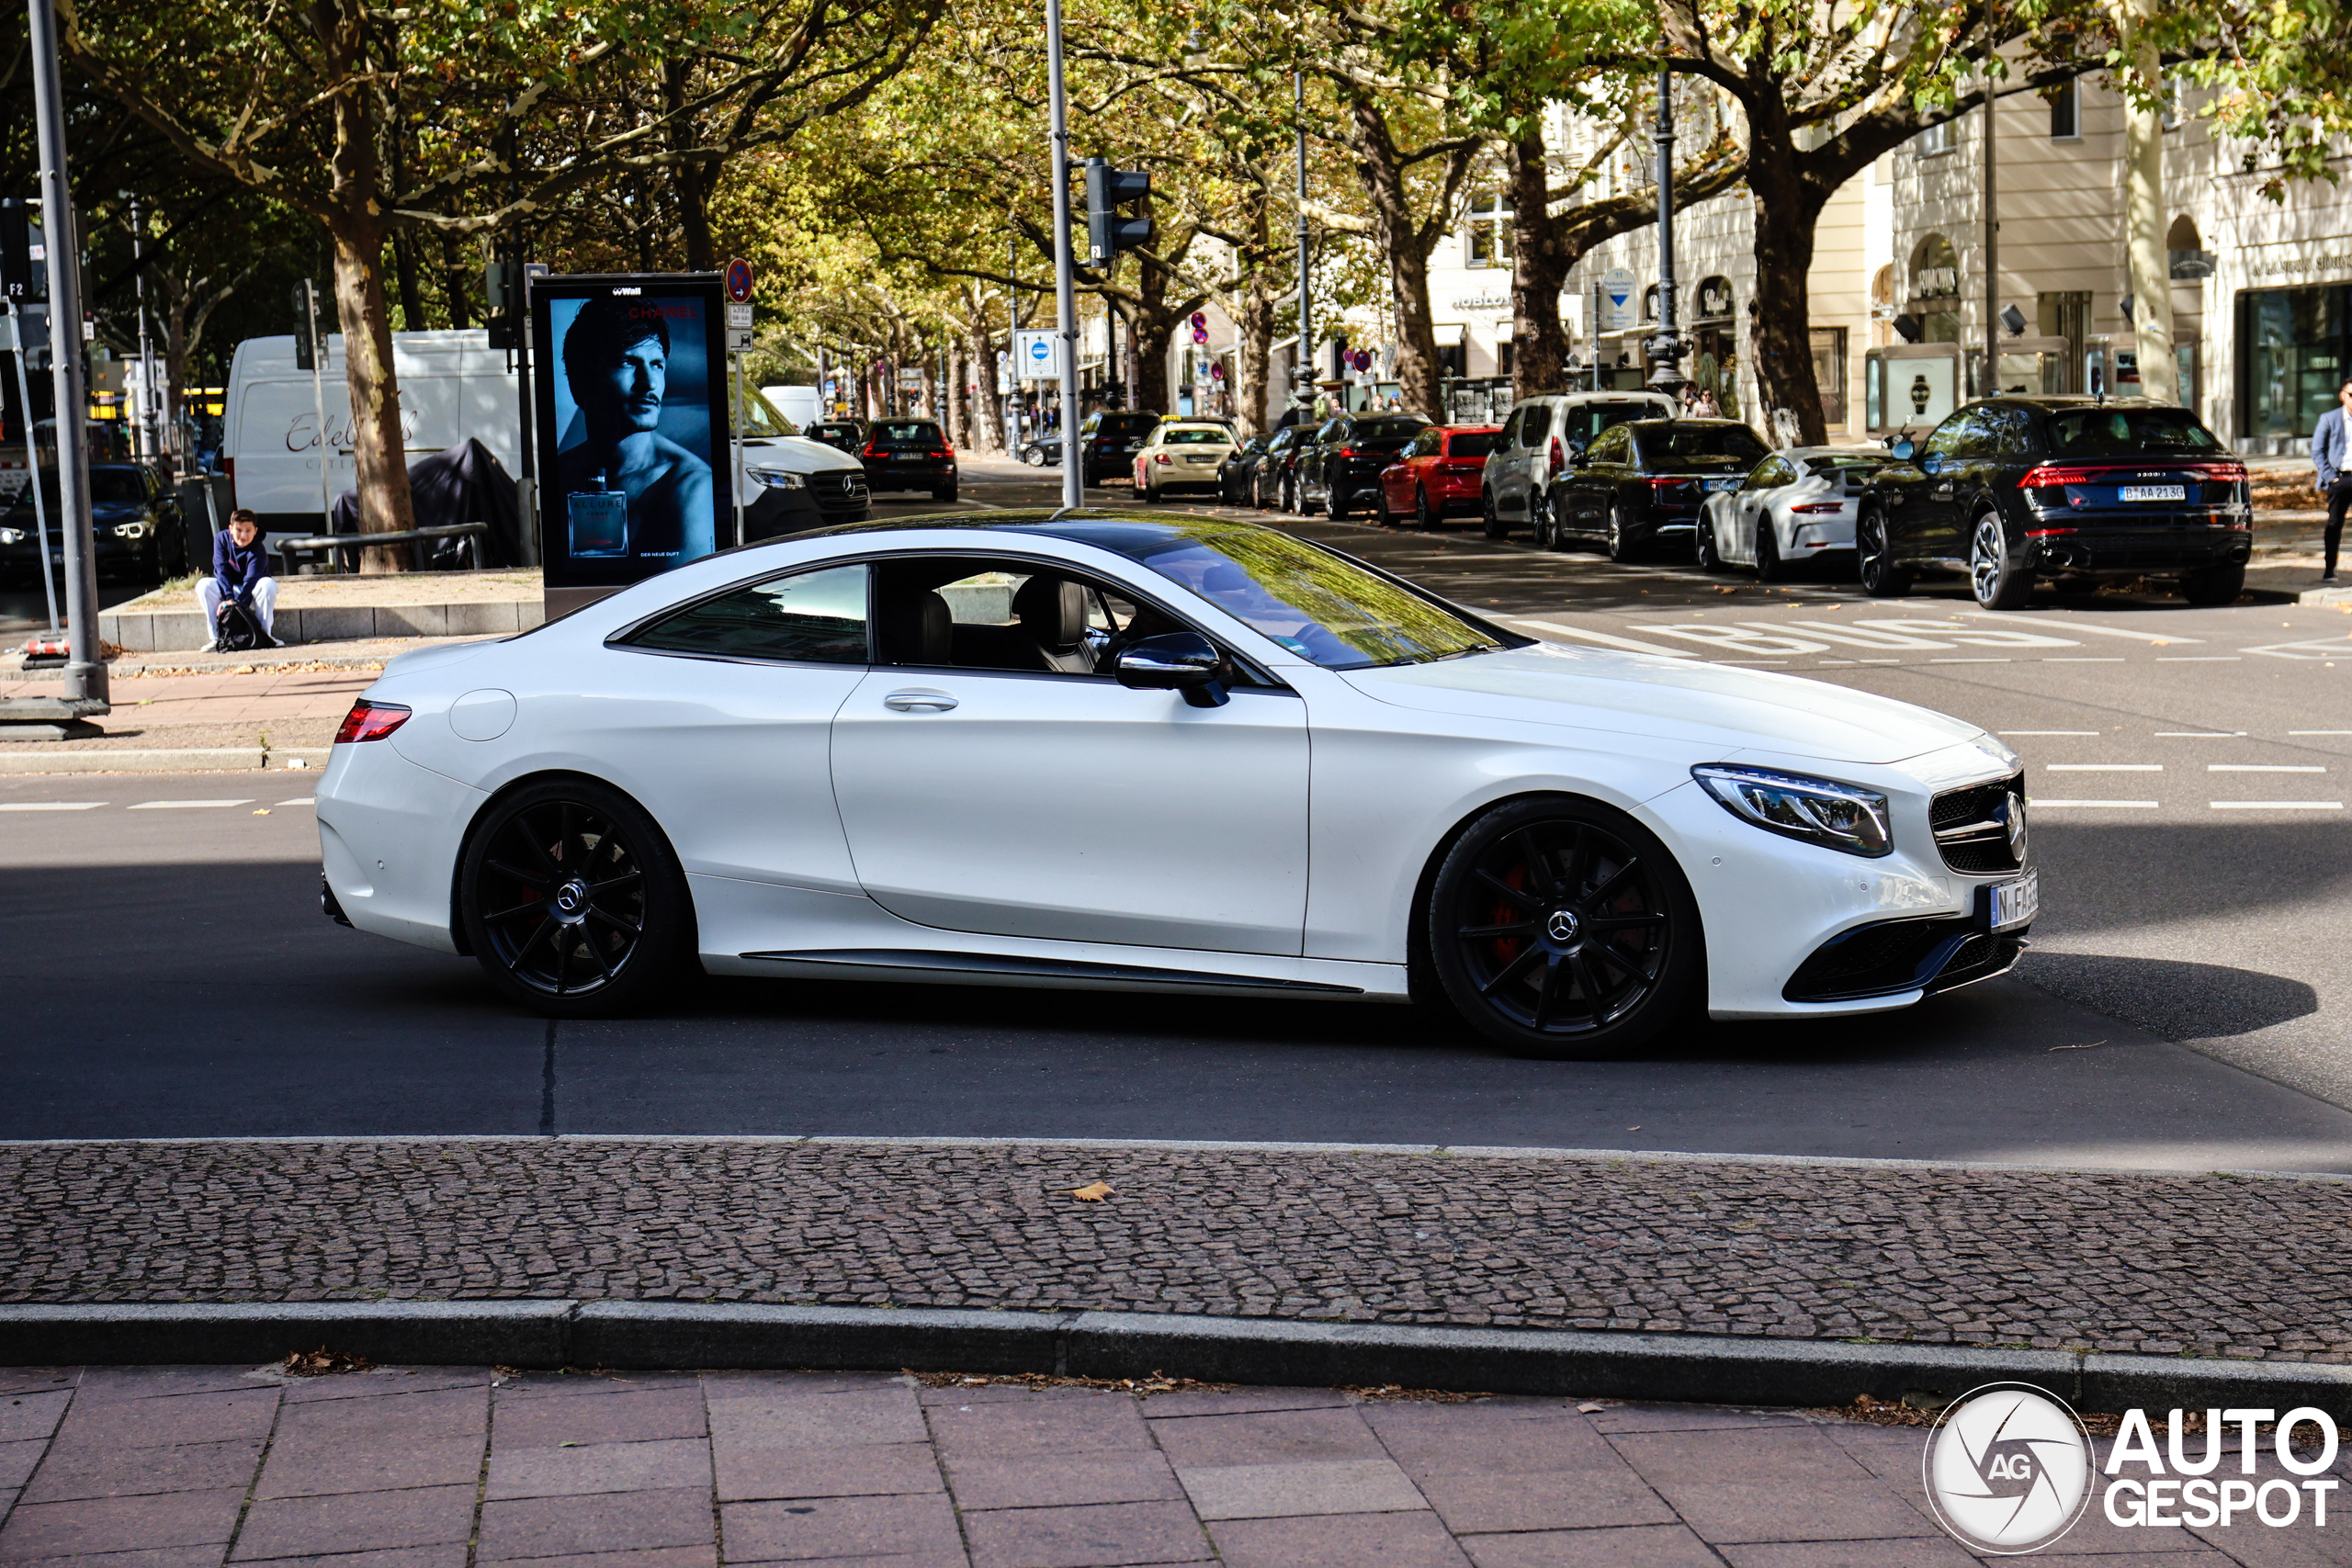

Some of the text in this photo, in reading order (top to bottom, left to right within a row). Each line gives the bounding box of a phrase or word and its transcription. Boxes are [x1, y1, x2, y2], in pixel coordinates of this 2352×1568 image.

[1918, 266, 1955, 292] RIMOWA
[9, 283, 24, 296] F2
[622, 287, 641, 296] Wall
[628, 306, 698, 319] CHANEL
[1710, 480, 1719, 490] HH
[2125, 487, 2183, 499] B AA 2130
[573, 500, 621, 508] ALLURE
[1626, 619, 2082, 655] BUS
[1998, 888, 2007, 921] N
